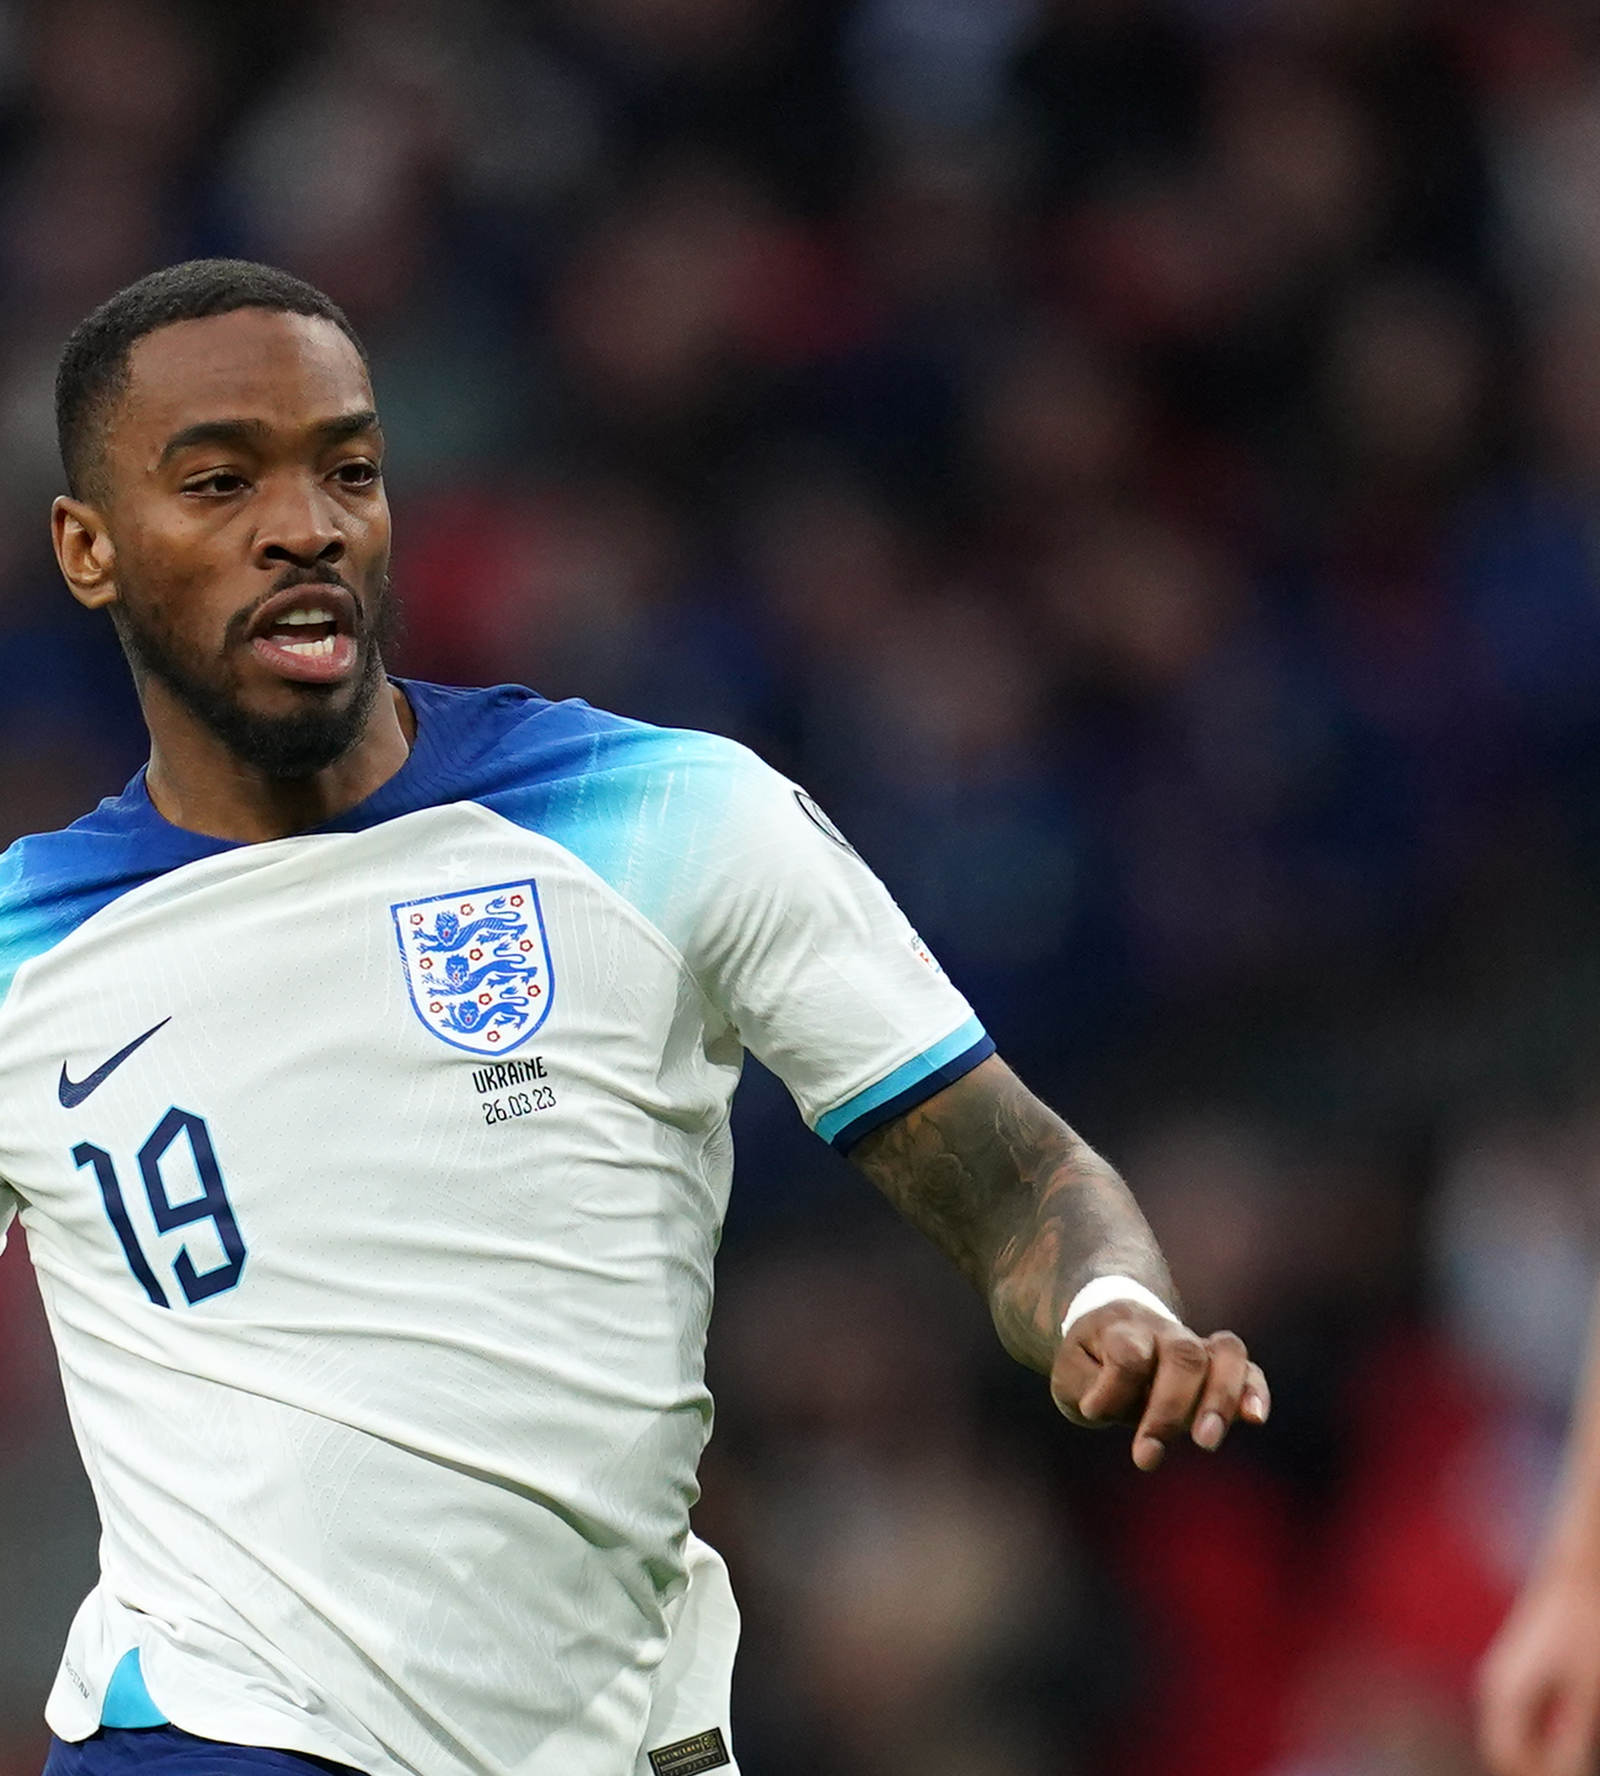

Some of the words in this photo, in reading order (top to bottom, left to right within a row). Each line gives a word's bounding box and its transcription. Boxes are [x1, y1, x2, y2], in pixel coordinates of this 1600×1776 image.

[472, 1056, 548, 1094] UKRAINE
[482, 1086, 557, 1125] 26.03.23
[69, 1104, 249, 1309] 19
